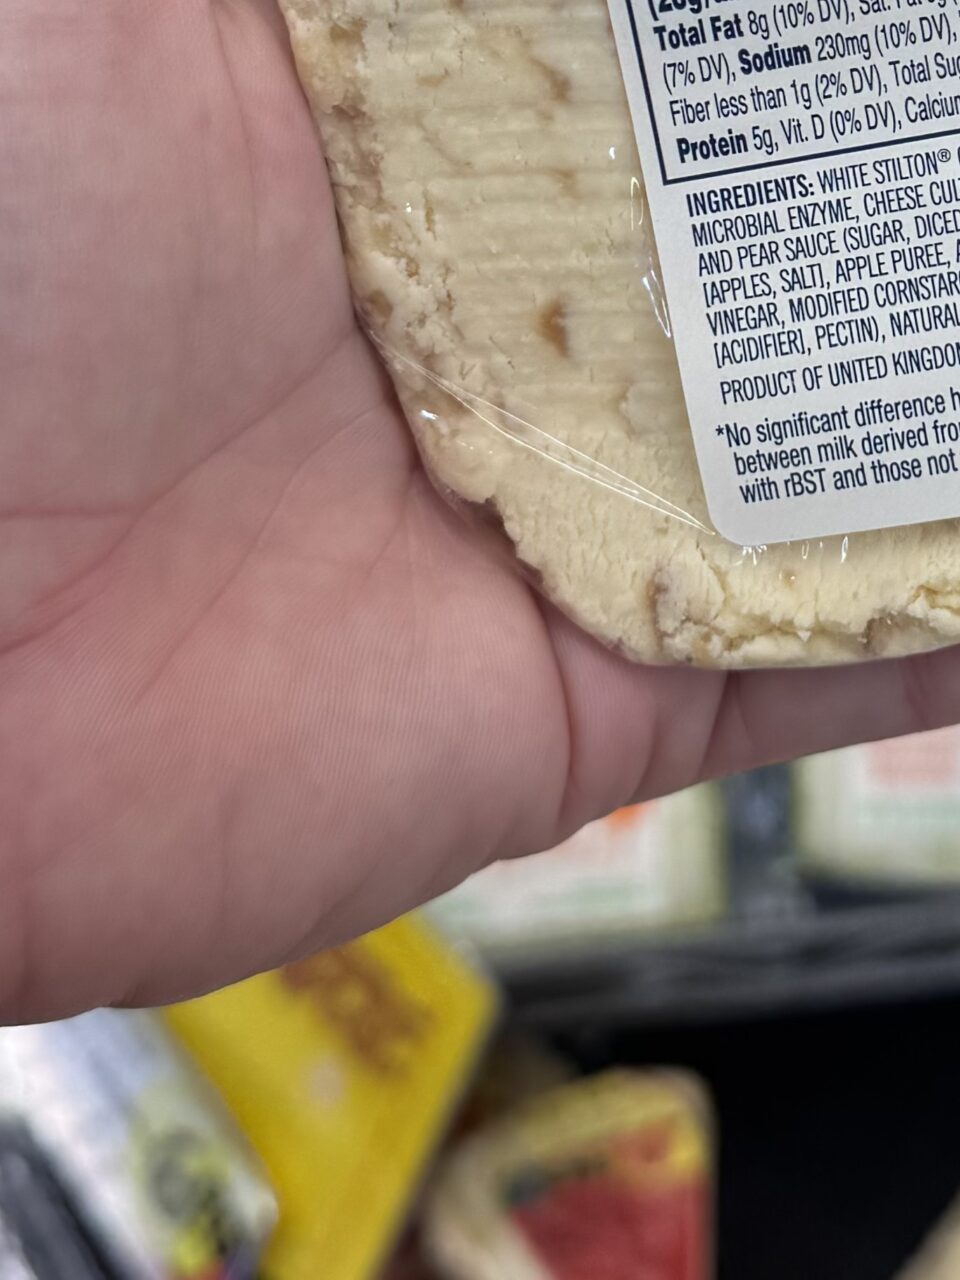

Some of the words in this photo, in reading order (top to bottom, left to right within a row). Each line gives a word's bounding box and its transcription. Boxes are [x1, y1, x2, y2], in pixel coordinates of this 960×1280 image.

[652, 17, 708, 52] Total
[709, 12, 745, 42] Fat
[772, 0, 815, 38] (10%
[662, 59, 696, 96] (7%
[696, 52, 737, 86] DV),
[737, 41, 813, 76] Sodium
[814, 32, 872, 62] 230mg
[874, 19, 917, 58] (10%
[918, 11, 958, 46] DV),
[668, 97, 711, 127] Fiber
[713, 92, 749, 119] less
[749, 85, 788, 113] than
[814, 71, 848, 108] (2%
[849, 63, 888, 97] DV),
[887, 54, 932, 87] Total
[675, 127, 749, 164] Protein
[779, 117, 809, 145] Vit.
[829, 107, 863, 144] (0%
[863, 100, 903, 134] DV),
[685, 173, 815, 218] INGREDIENTS:
[816, 162, 872, 195] WHITE
[691, 209, 786, 248] MICROBIAL
[786, 196, 860, 231] ENZYME,
[863, 183, 928, 218] CHEESE
[698, 249, 733, 278] AND
[736, 240, 782, 270] PEAR
[783, 229, 841, 262] SAUCE
[842, 218, 911, 254] (SUGAR,
[835, 251, 889, 285] APPLE
[890, 241, 951, 274] PUREE,
[705, 301, 786, 337] VINEGAR,
[788, 286, 870, 324] MODIFIED
[814, 315, 886, 351] PECTIN),
[719, 368, 797, 406] PRODUCT
[801, 364, 823, 392] OF
[827, 355, 888, 388] UNITED
[755, 405, 852, 446] significant
[854, 393, 947, 428] difference
[733, 446, 813, 476] between
[816, 434, 858, 464] milk
[861, 421, 930, 457] derived
[739, 476, 781, 504] with
[783, 467, 827, 498] rBST
[832, 461, 868, 491] and
[869, 457, 923, 485] those
[926, 447, 959, 476] not
